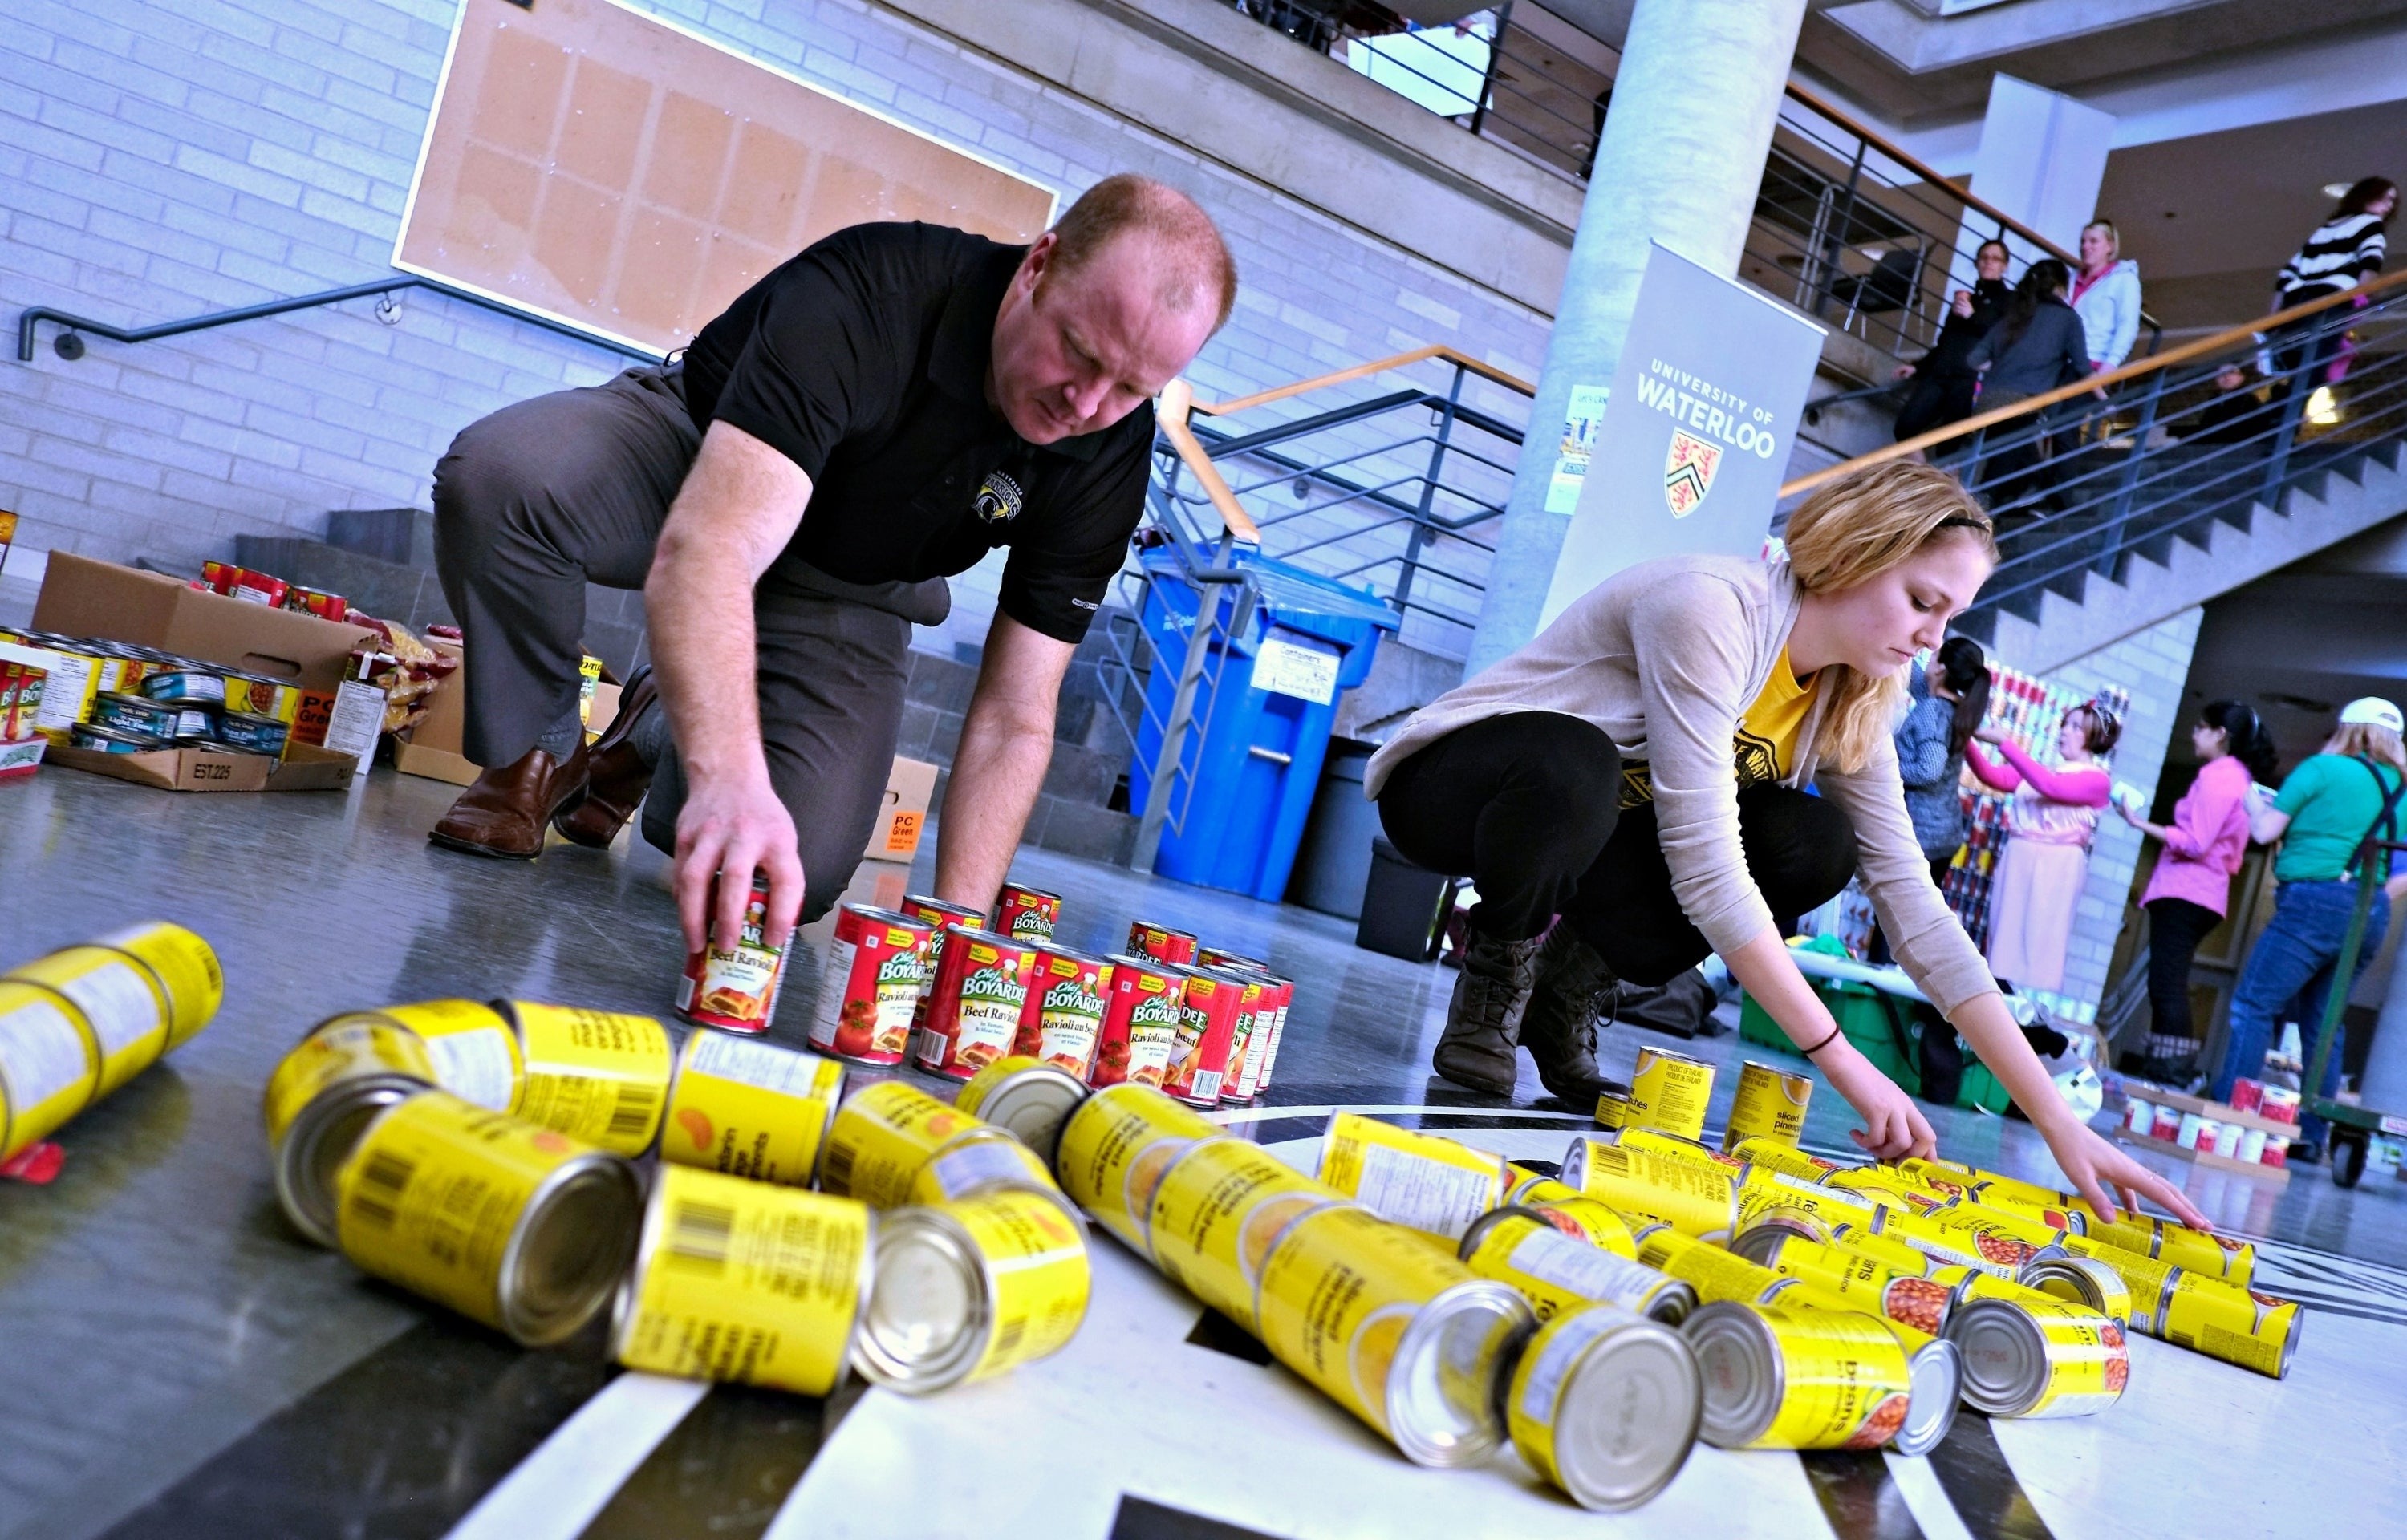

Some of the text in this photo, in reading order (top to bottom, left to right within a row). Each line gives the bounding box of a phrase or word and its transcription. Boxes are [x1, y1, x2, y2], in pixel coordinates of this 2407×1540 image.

[1651, 359, 1774, 425] UNIVERSITY OF
[1638, 373, 1775, 459] WATERLOO
[108, 716, 129, 727] Light
[131, 721, 154, 732] Tuna
[193, 763, 232, 780] EST.225
[895, 816, 913, 826] PC
[892, 825, 913, 837] Green
[1021, 910, 1039, 920] Chef
[891, 950, 914, 965] Chef
[879, 962, 923, 981] BOYAR
[975, 968, 1000, 982] Chef
[1055, 982, 1080, 995] Chef
[878, 992, 907, 1003] Ravioli
[1144, 997, 1165, 1010] Chef
[964, 1006, 1017, 1024] Beef Ravioli
[1132, 1006, 1180, 1025] BOYARD
[1043, 1019, 1074, 1030] Ravioli
[1131, 1033, 1160, 1043] Ravioli
[1175, 1028, 1197, 1047] bœuf
[1667, 1063, 1683, 1072] PRODUCT
[1665, 1072, 1680, 1081] PRODUIT
[1628, 1096, 1647, 1110] nches
[1777, 1111, 1800, 1122] sliced
[1774, 1121, 1800, 1133] pineapp
[1803, 1199, 1819, 1212] fè
[1857, 1258, 1877, 1281] ans
[1839, 1267, 1853, 1293] sauce
[1833, 1360, 1857, 1433] beans
